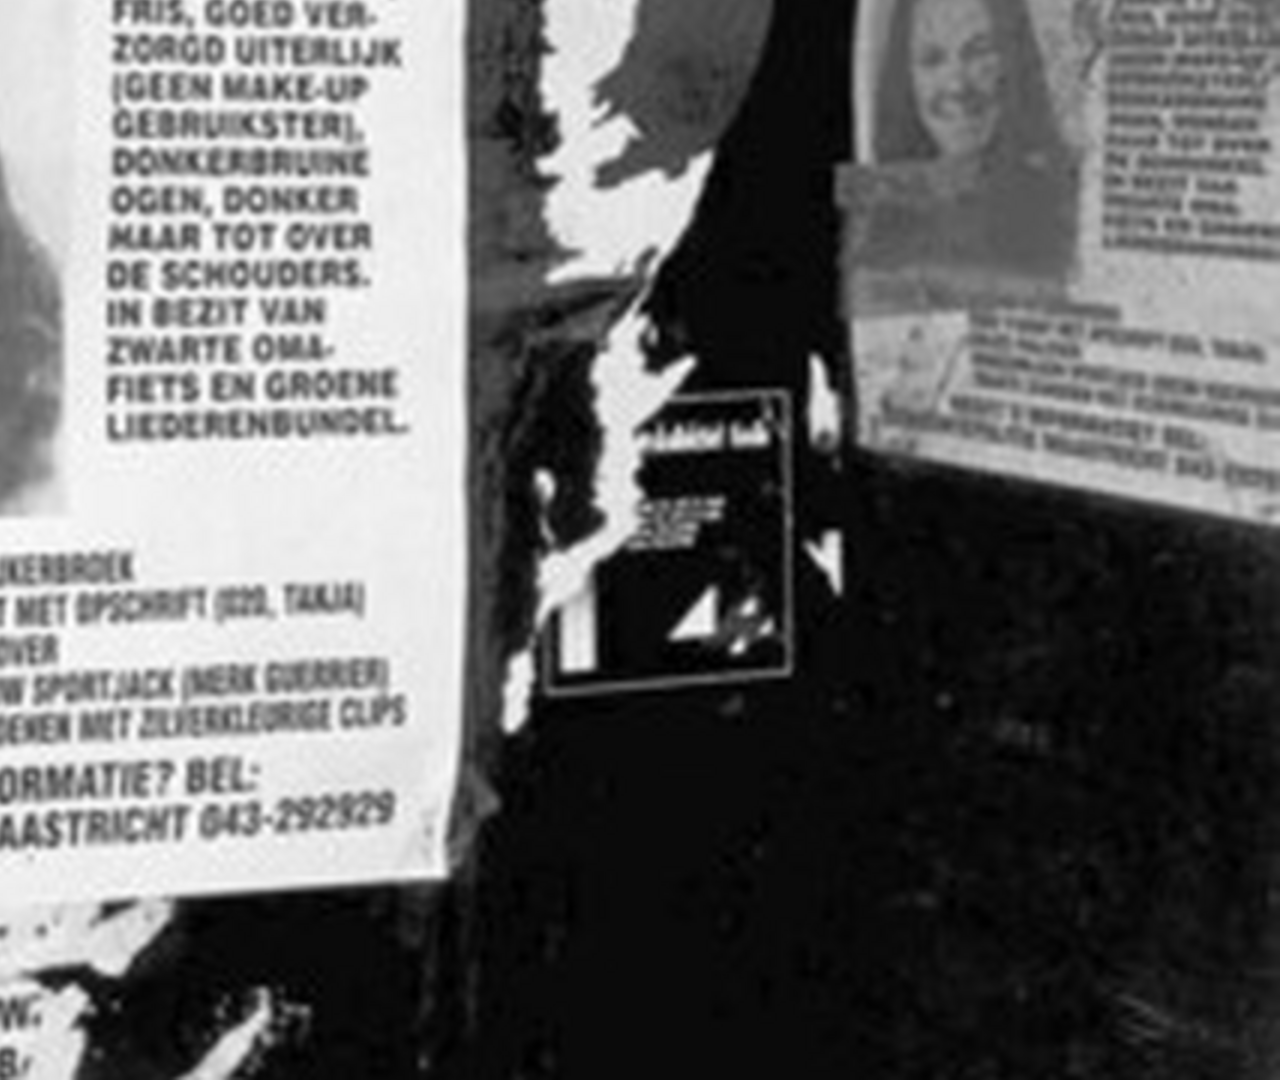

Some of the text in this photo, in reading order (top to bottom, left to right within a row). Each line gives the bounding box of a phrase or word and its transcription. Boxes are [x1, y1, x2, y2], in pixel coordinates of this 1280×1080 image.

[112, 33, 403, 68] ZORGD UITERLIJK
[222, 74, 370, 104] MAKE-UP
[112, 146, 370, 177] DONKERBRUINE
[110, 185, 359, 218] OGEN, DONKER
[213, 222, 276, 251] TOT
[285, 222, 372, 251] OVER
[106, 259, 371, 290] DE SCHOUDERS.
[107, 297, 326, 328] IN BEZIT VAN
[107, 333, 335, 366] ZWARTE OMA-
[107, 369, 398, 404] FIETS EN GROENE
[107, 408, 409, 443] LIEDERENBUNDEL.
[15, 594, 67, 627] MET
[74, 586, 208, 626] OPSCHRIFT
[33, 668, 176, 705] SPORTJACK
[78, 709, 131, 742] MET
[139, 698, 331, 740] ZILVERKLEURIGE
[339, 693, 407, 729] CLIPS
[185, 756, 260, 797] BEL:
[199, 790, 396, 840] 043-292929
